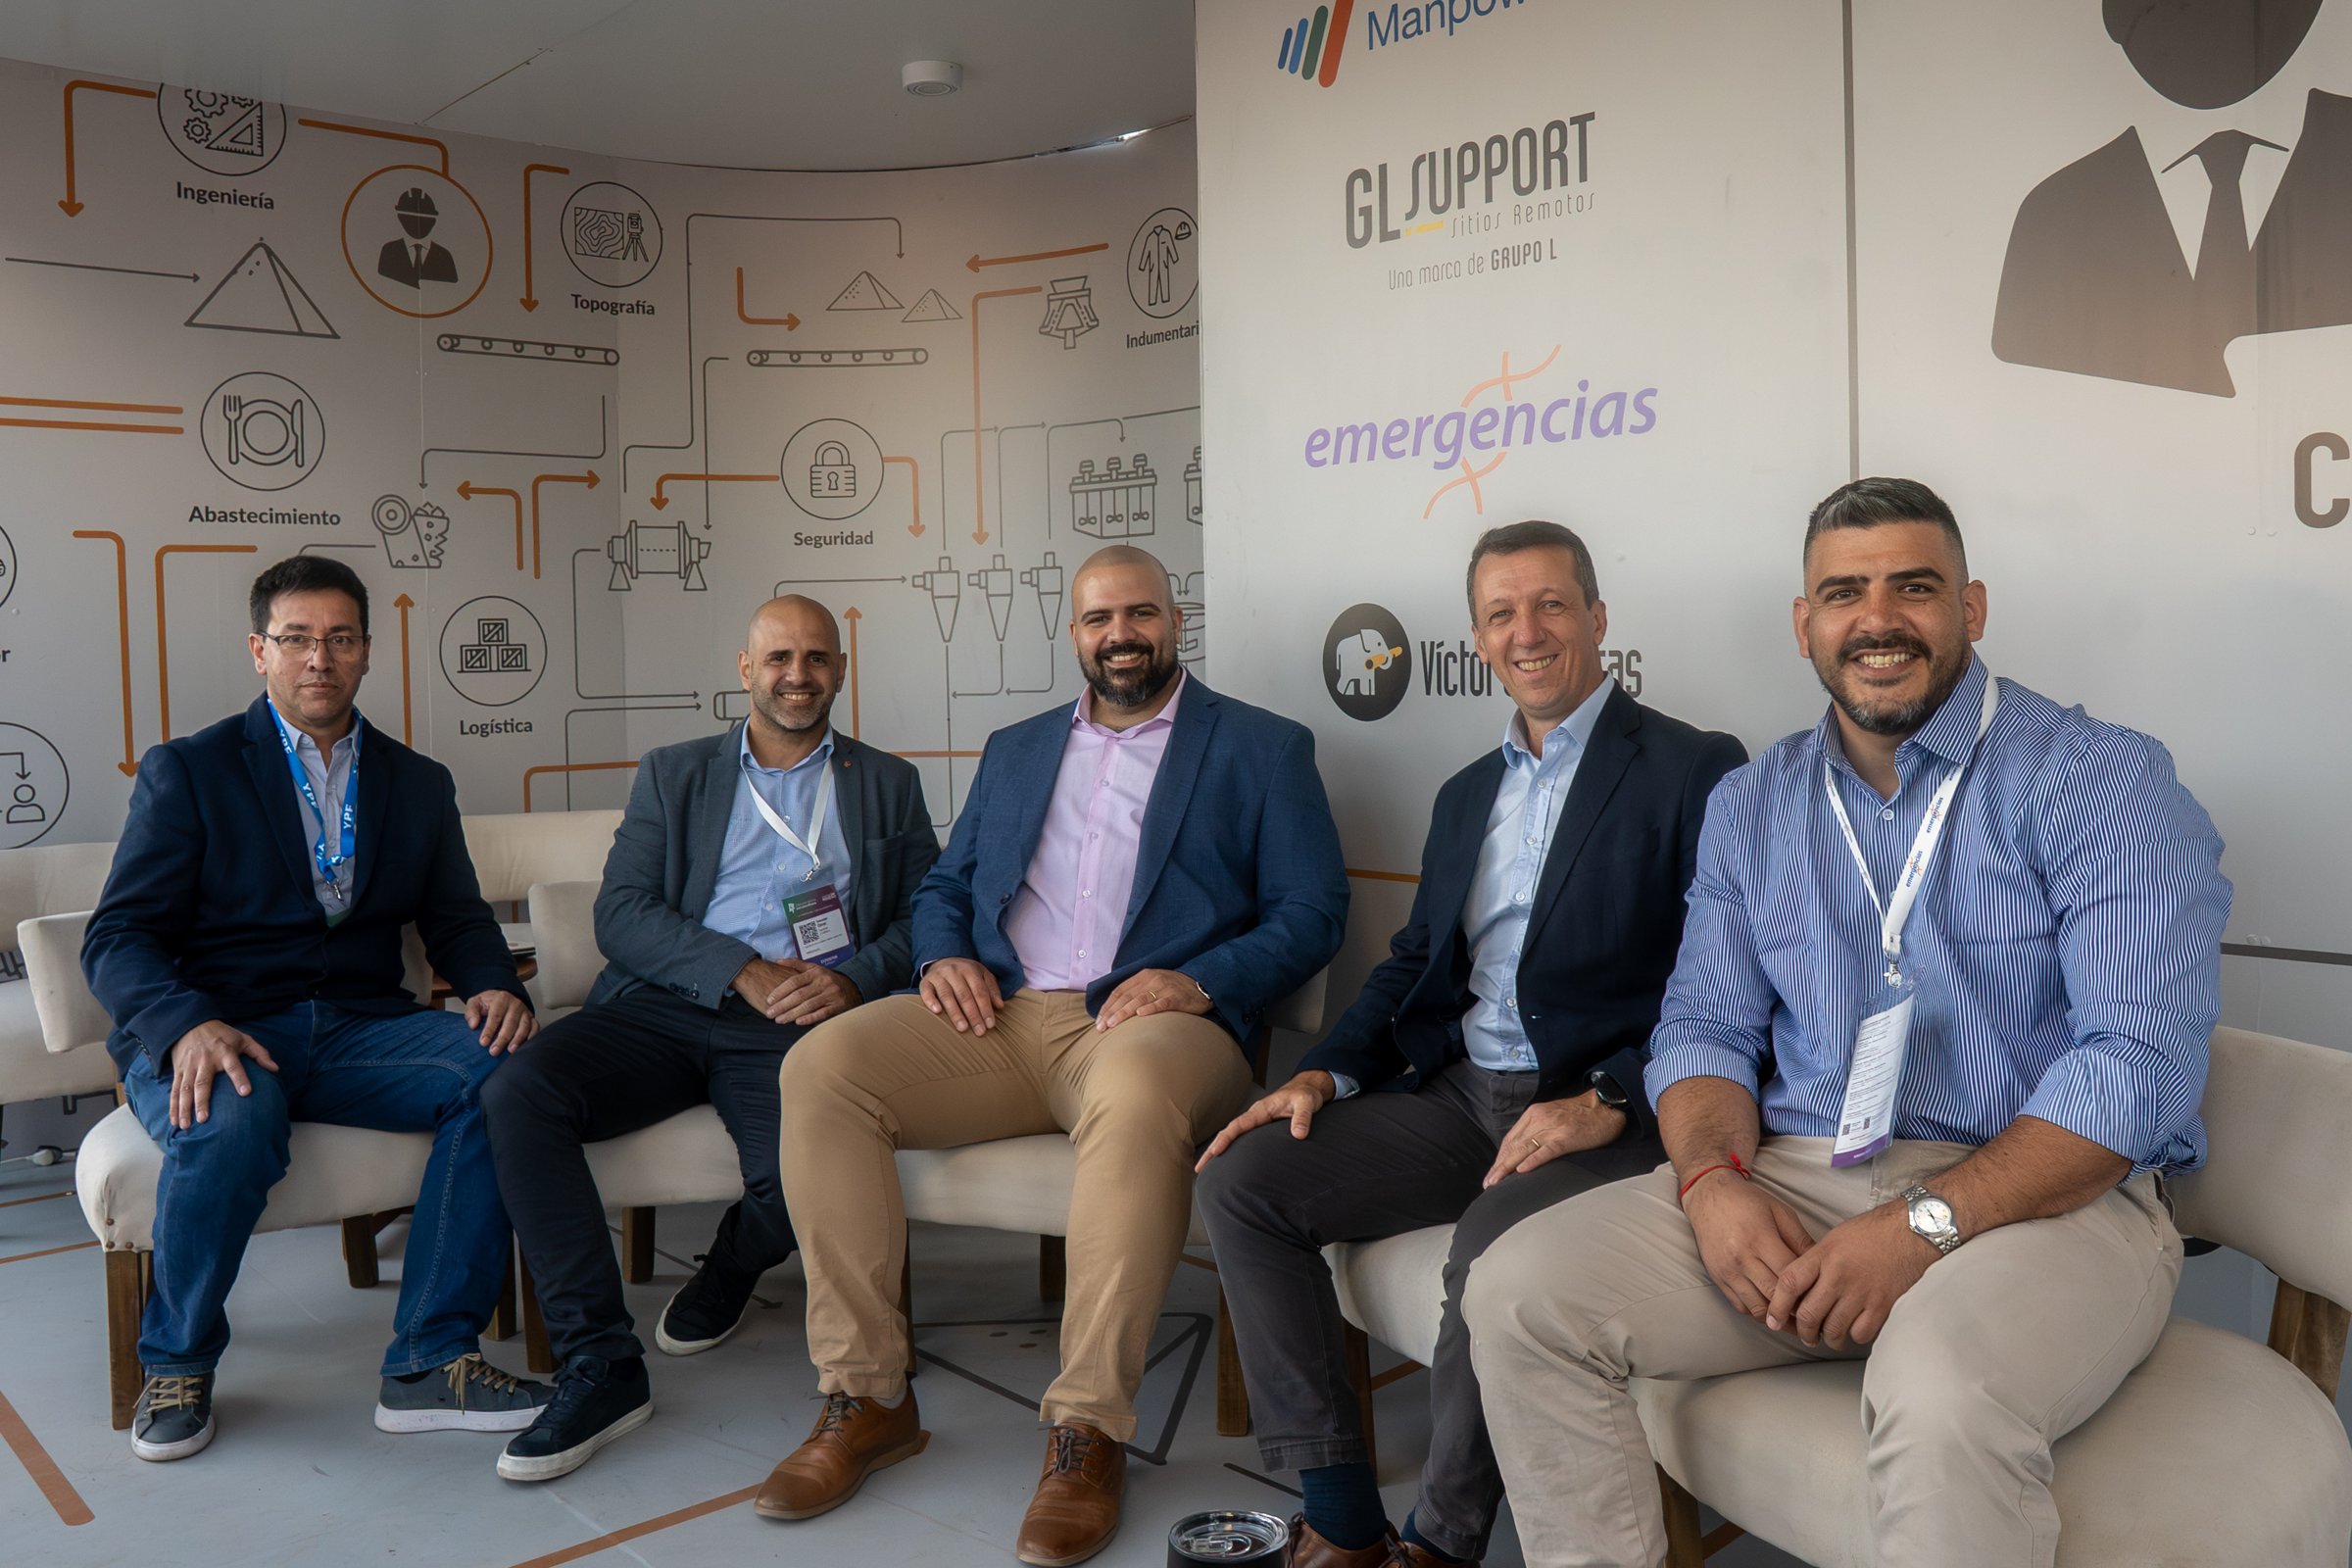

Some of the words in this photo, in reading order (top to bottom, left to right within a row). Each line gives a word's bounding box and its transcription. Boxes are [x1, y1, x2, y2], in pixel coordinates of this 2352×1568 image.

[1368, 0, 1526, 50] Manpo
[176, 181, 274, 210] Ingeniería
[1346, 163, 1400, 249] GL
[1404, 112, 1595, 221] SUPPORT
[1513, 192, 1594, 225] Remotos
[1389, 269, 1413, 290] Una
[1419, 260, 1461, 285] marca
[1467, 252, 1485, 275] de
[1491, 240, 1543, 270] GRUPO
[1549, 238, 1557, 261] L
[570, 294, 656, 316] Topografía
[1304, 379, 1658, 470] emergencias
[188, 505, 341, 526] Abastecimiento
[793, 530, 874, 549] Seguridad
[460, 716, 533, 738] Logística
[343, 804, 354, 829] YPF
[1926, 797, 1944, 834] emergencias
[1905, 850, 1923, 888] emergencias
